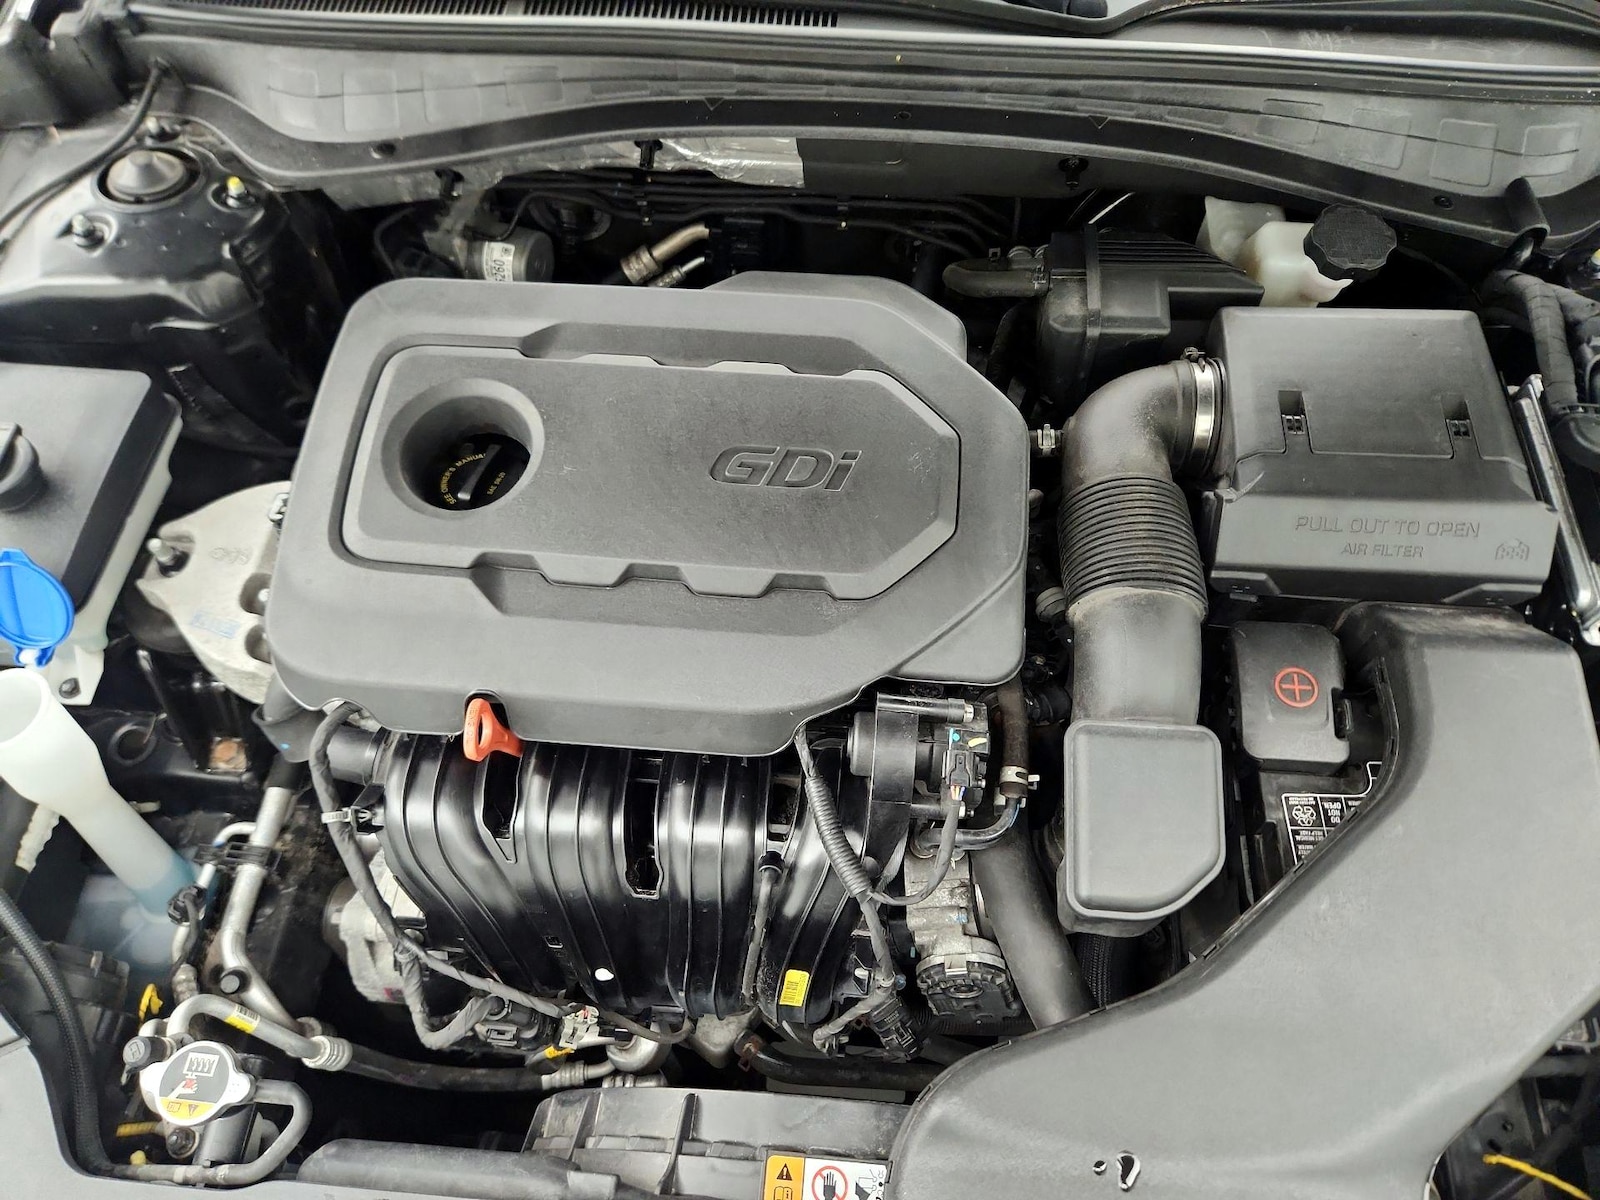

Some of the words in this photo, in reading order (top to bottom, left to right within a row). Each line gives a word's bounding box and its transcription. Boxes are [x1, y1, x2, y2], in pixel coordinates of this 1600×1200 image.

[708, 444, 863, 491] GDi
[444, 493, 457, 505] SEE
[1295, 516, 1343, 533] PULL
[1350, 518, 1389, 534] OUT
[1394, 519, 1420, 535] TO
[1426, 521, 1480, 538] OPEN
[1341, 542, 1368, 556] AIR
[1371, 543, 1424, 558] FILTER
